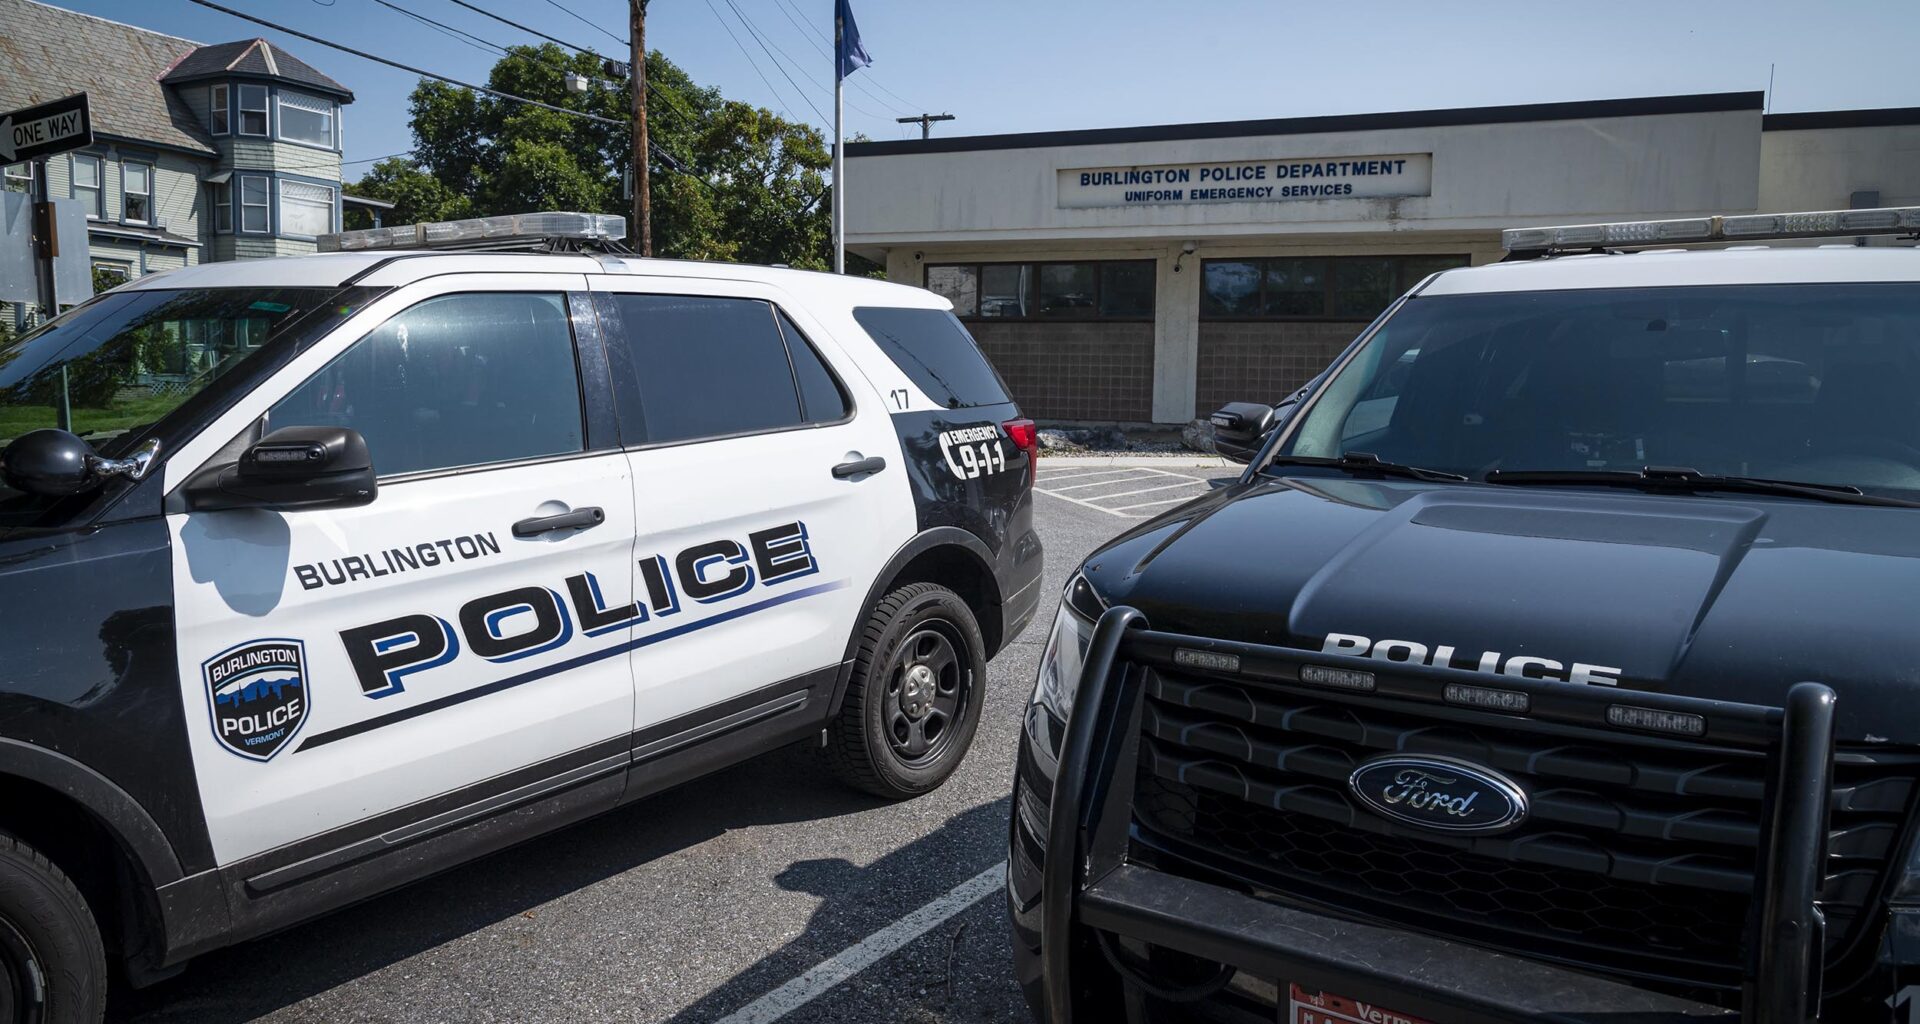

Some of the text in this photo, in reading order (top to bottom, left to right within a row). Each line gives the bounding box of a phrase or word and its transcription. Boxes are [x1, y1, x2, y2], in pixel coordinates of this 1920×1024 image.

[14, 112, 77, 147] ONE WAY
[1080, 160, 1406, 187] BURLINGTON POLICE DEPARTMENT
[1125, 184, 1353, 202] UNIFORM EMERGENCY SERVICES
[890, 389, 909, 410] 17
[951, 425, 999, 444] EMERGENCY
[959, 440, 1005, 479] 9-1-1
[293, 532, 501, 590] BURLINGTON
[338, 519, 819, 700] POLICE
[212, 649, 297, 682] BURLINGTON
[222, 698, 300, 736] POLICE
[245, 728, 285, 746] VERMONT
[1382, 769, 1479, 817] Ford
